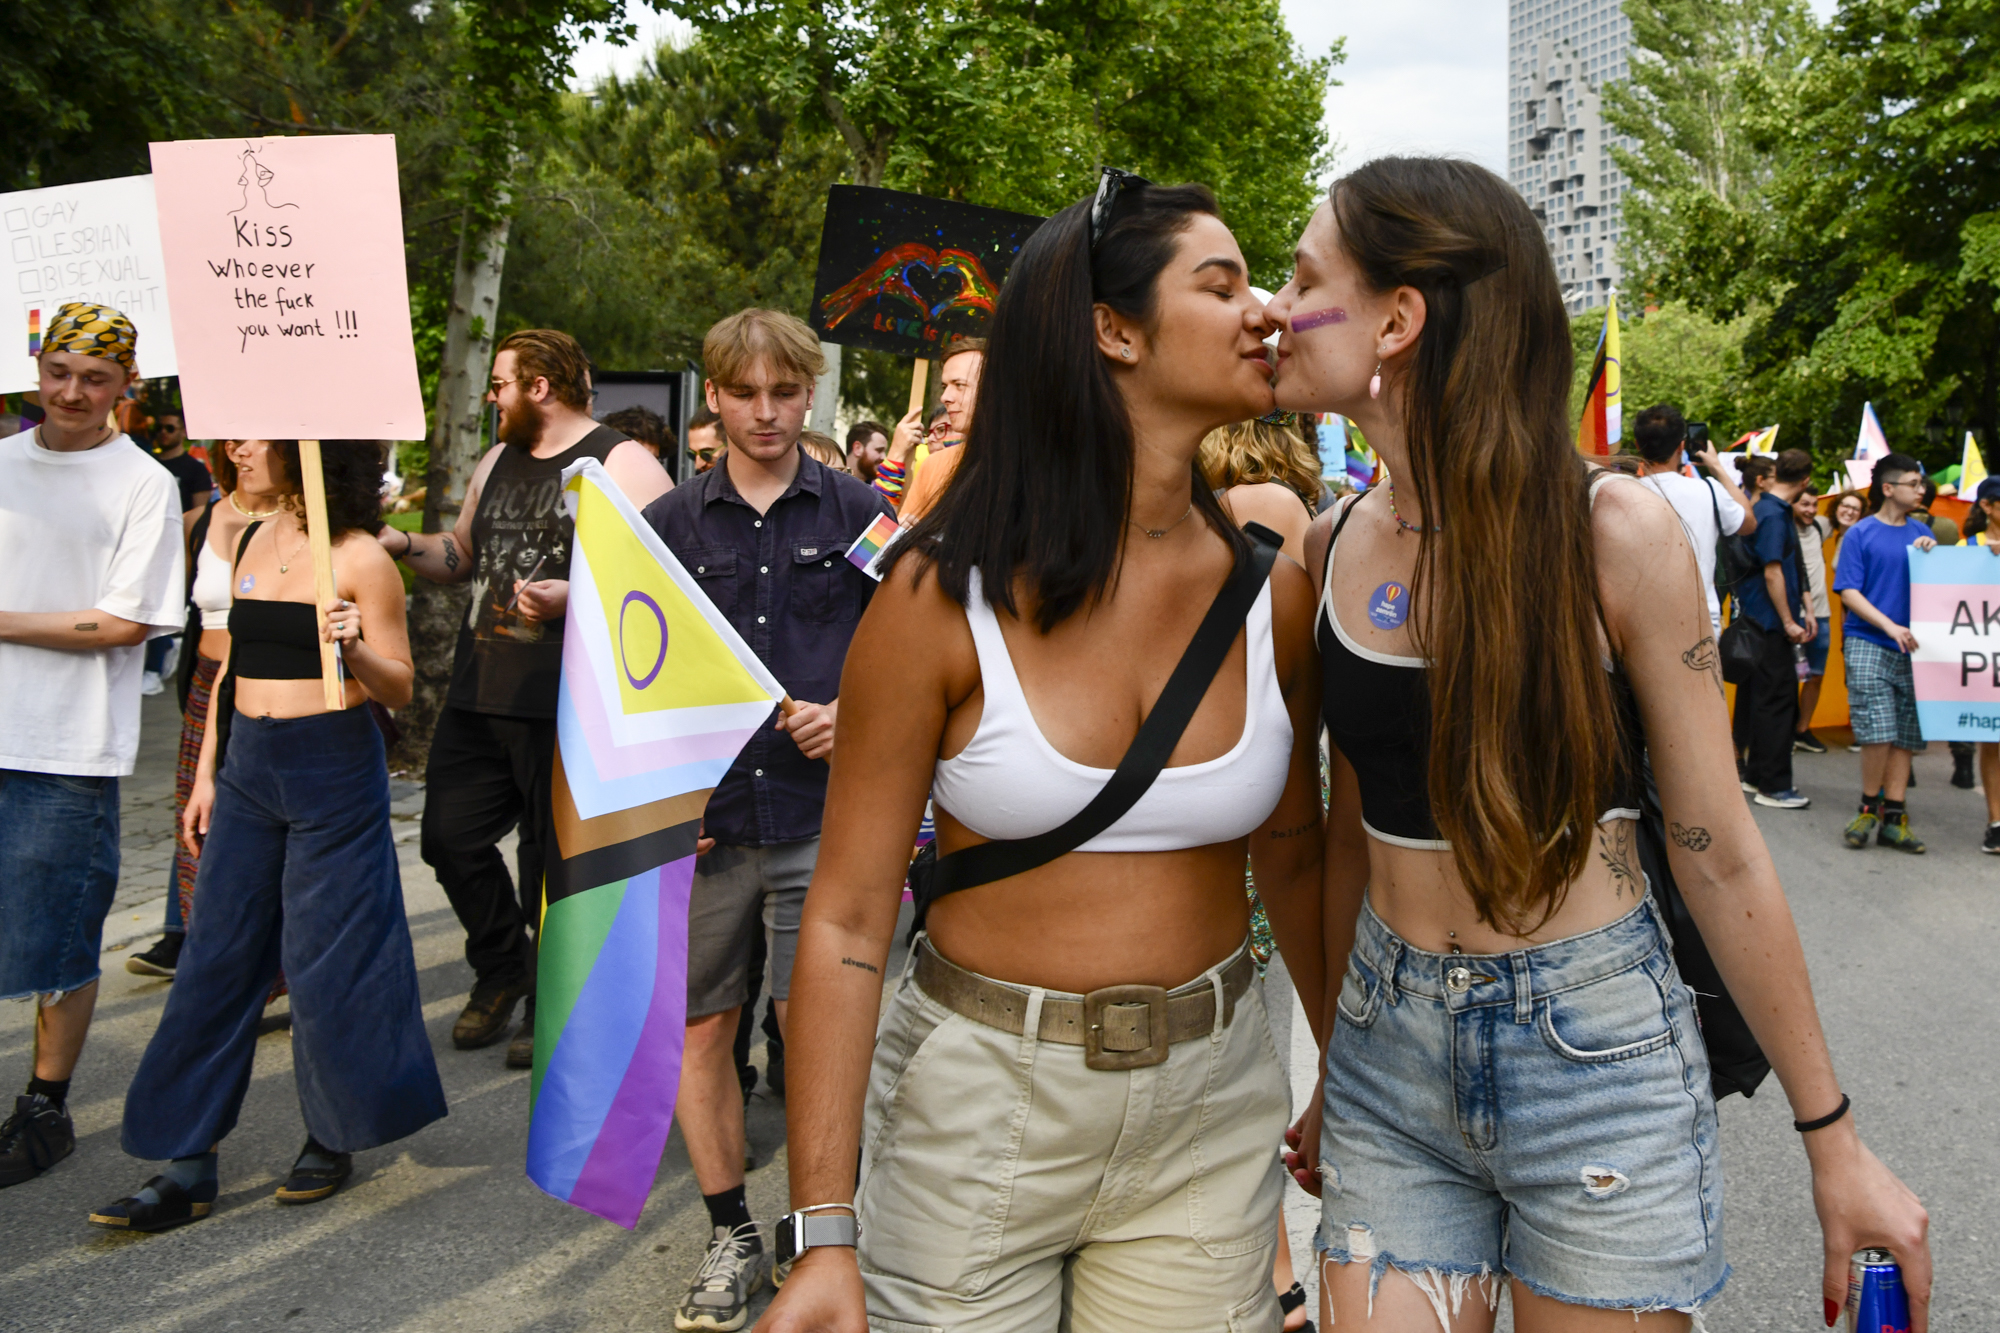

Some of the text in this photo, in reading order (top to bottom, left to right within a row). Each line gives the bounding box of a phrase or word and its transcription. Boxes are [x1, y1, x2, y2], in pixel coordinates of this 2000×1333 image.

[32, 200, 79, 228] GAY
[38, 223, 131, 259] LESBIAN
[233, 215, 293, 248] Kiss
[43, 255, 150, 292] BISEXUAL
[234, 286, 315, 317] the fuck
[236, 310, 359, 354] you want !!!
[873, 312, 922, 339] LOVE
